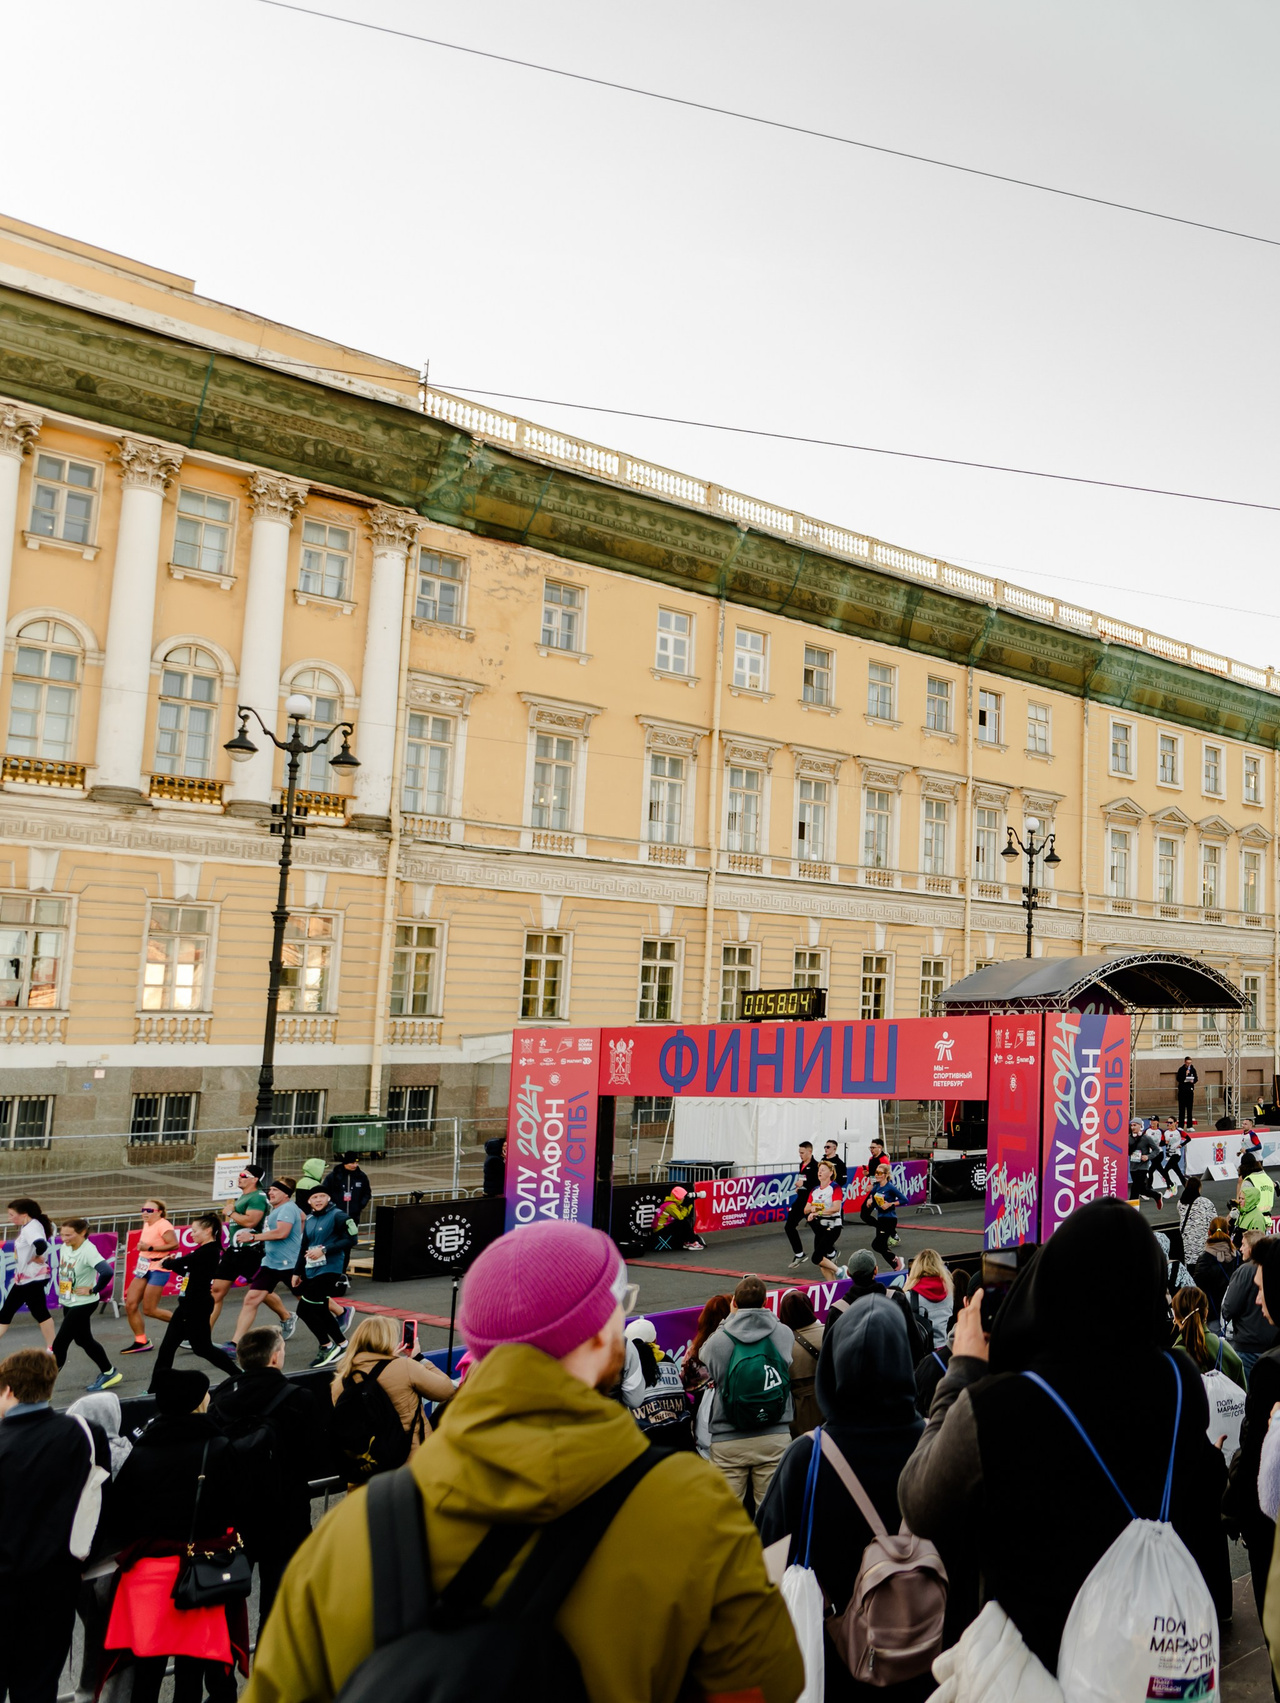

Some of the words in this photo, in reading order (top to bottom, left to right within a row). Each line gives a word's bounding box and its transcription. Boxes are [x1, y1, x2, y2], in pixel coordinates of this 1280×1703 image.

[659, 1025, 898, 1093] ФИНИШ
[933, 1071, 972, 1079] СПОРТИВНЫЙ
[1052, 1013, 1081, 1130] 2024
[516, 1074, 544, 1159] 2024
[1079, 1048, 1101, 1206] АРАФОН
[539, 1099, 565, 1222] АРАФОН
[631, 1195, 661, 1210] БЕГОВО
[713, 1178, 755, 1197] ПОЛУ
[427, 1240, 472, 1262] СООБЩЕСТВО
[766, 1283, 838, 1316] ПЛУ
[632, 1398, 683, 1419] WREXHAM
